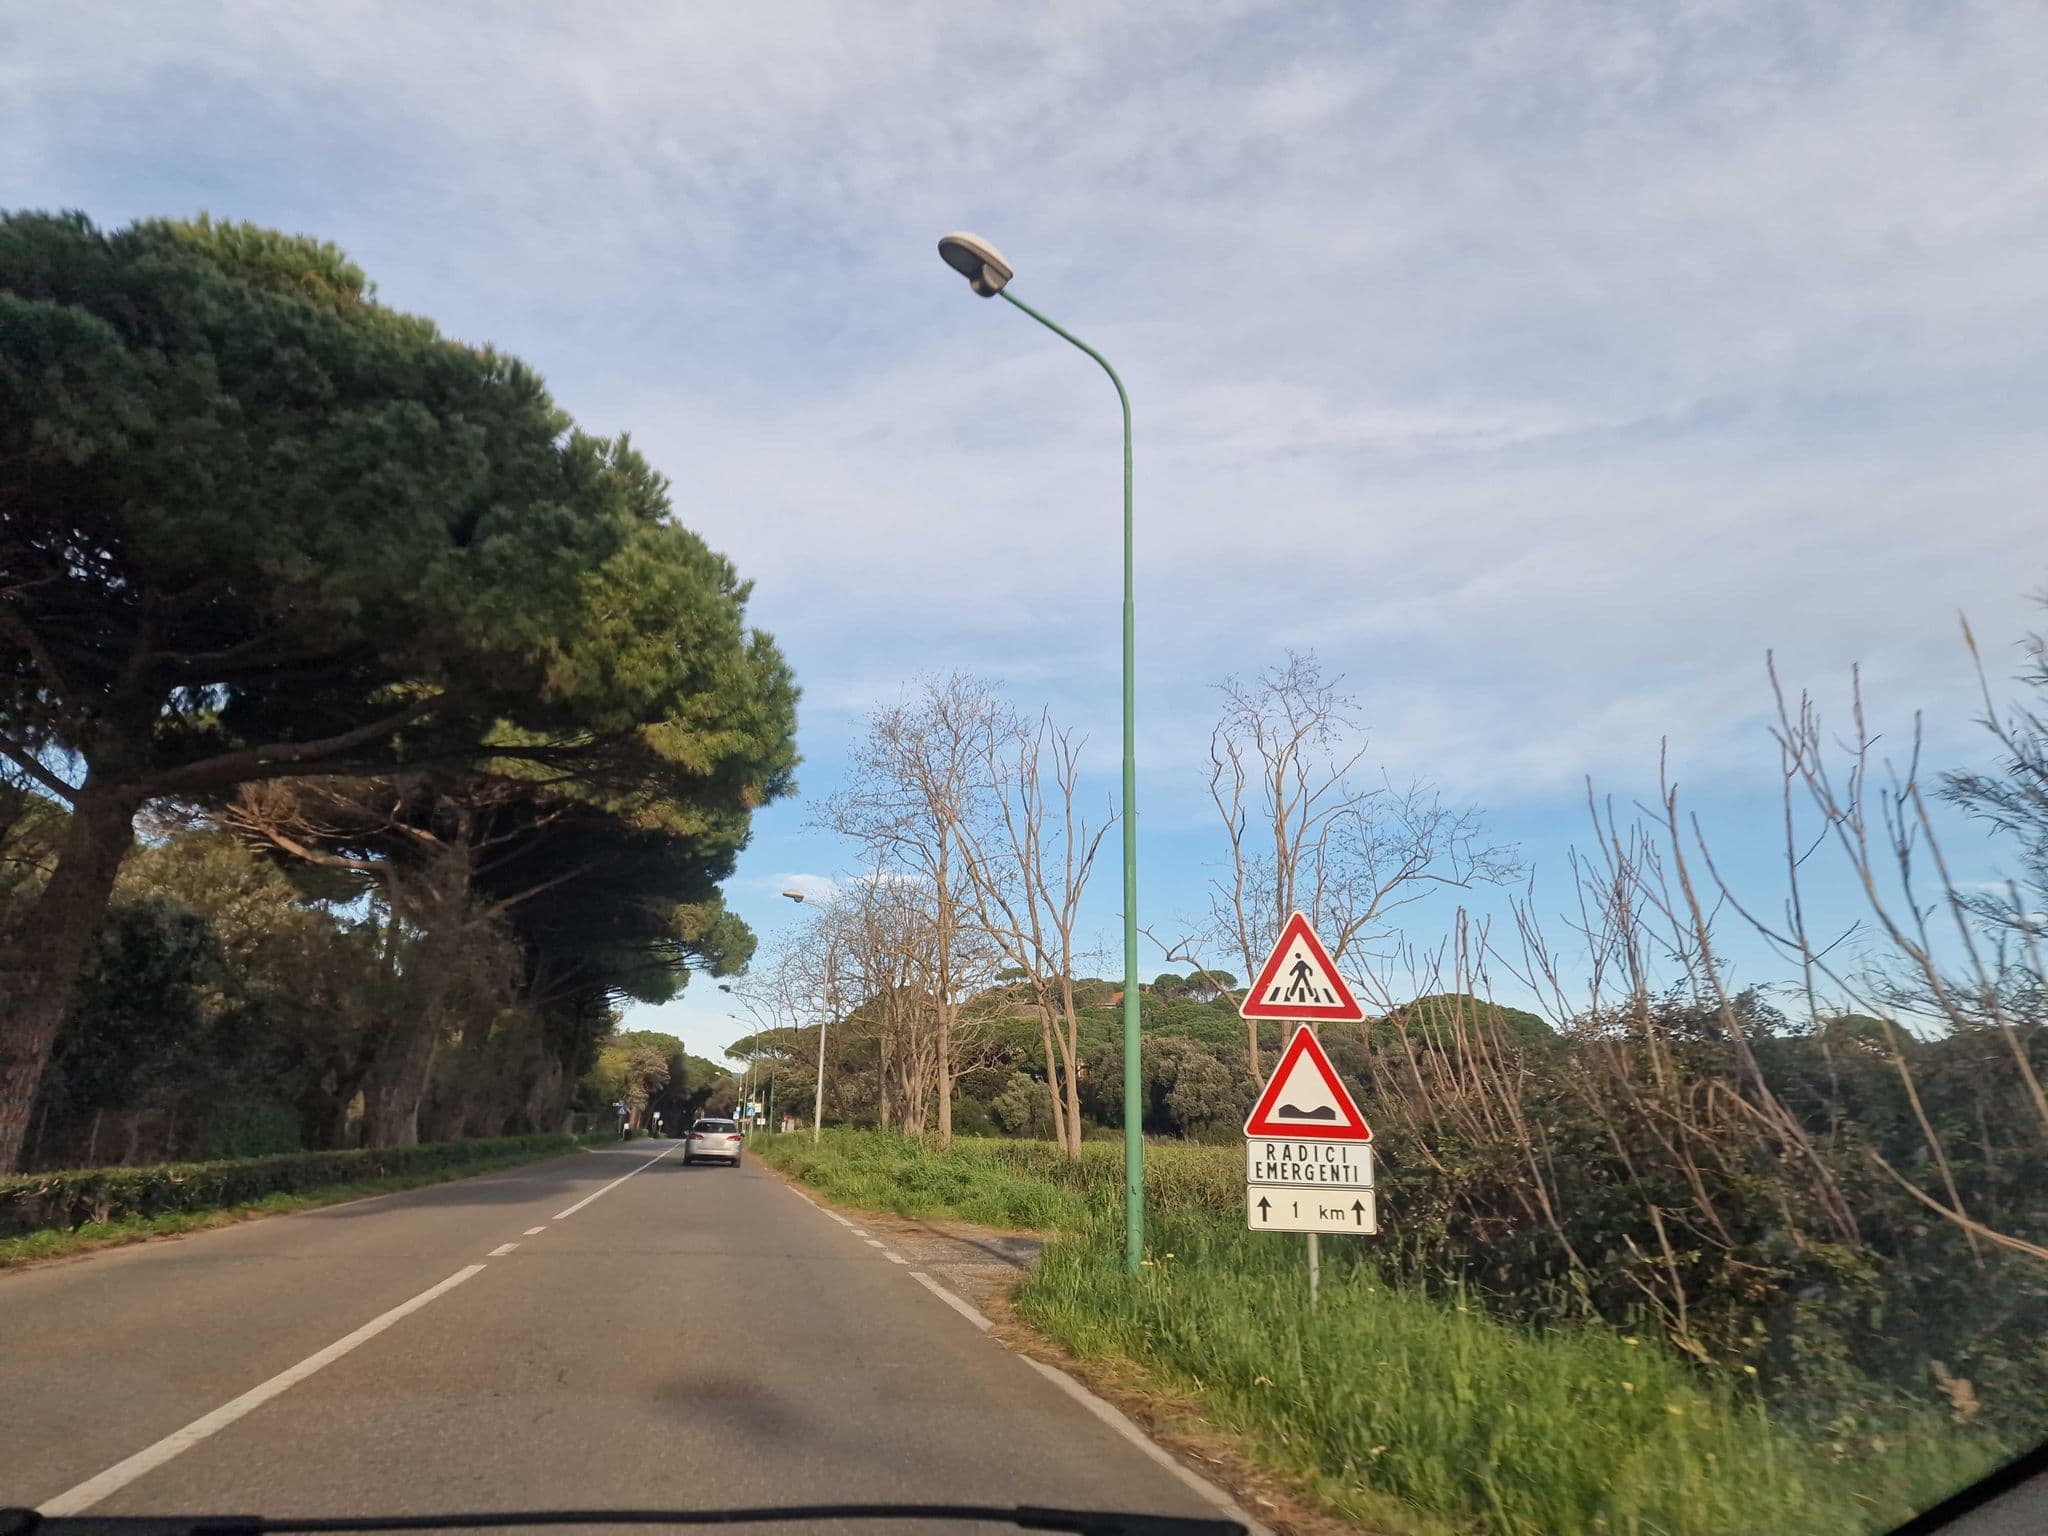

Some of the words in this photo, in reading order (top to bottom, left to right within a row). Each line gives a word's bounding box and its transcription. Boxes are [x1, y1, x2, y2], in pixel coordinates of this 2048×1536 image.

[1266, 1143, 1346, 1163] RADICI
[1255, 1161, 1358, 1182] EMERGENTI
[1292, 1201, 1298, 1218] 1
[1319, 1205, 1345, 1220] km
